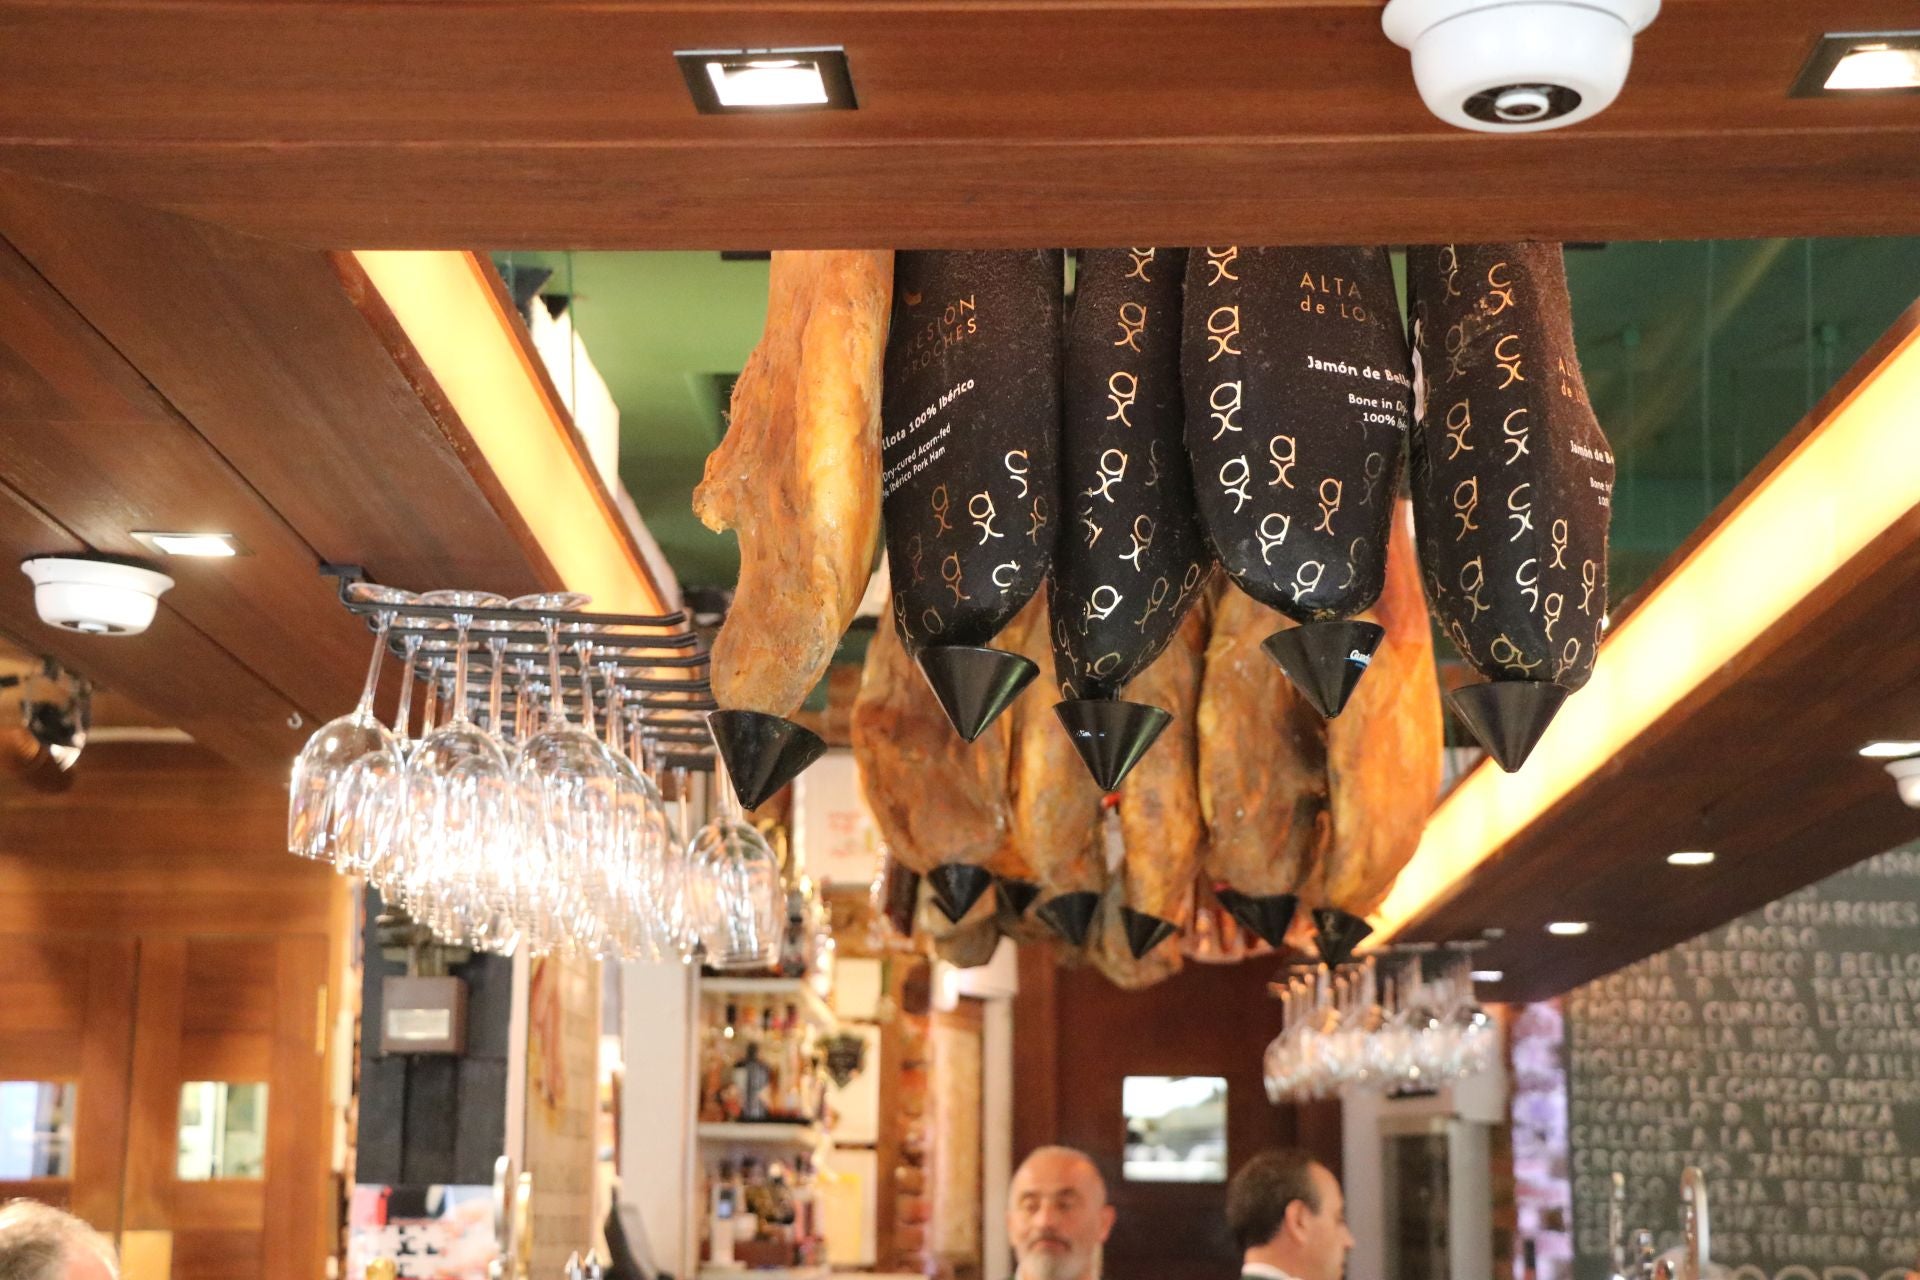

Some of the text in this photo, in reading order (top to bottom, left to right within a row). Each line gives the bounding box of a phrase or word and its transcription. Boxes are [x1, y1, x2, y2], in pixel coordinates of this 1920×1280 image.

[1300, 272, 1362, 299] ALTA
[1301, 295, 1325, 314] de
[1307, 355, 1358, 377] Jamón
[1362, 366, 1381, 380] de
[909, 404, 937, 434] 100%
[939, 379, 974, 410] Ibérico
[1349, 393, 1378, 408] Bone
[1382, 398, 1393, 410] in
[1363, 412, 1396, 427] 100%
[883, 423, 951, 482] Dry-cured Acorn-fed
[1594, 449, 1604, 462] de
[889, 471, 912, 493] Ibérico
[913, 459, 928, 474] Pork
[929, 446, 946, 463] Ham
